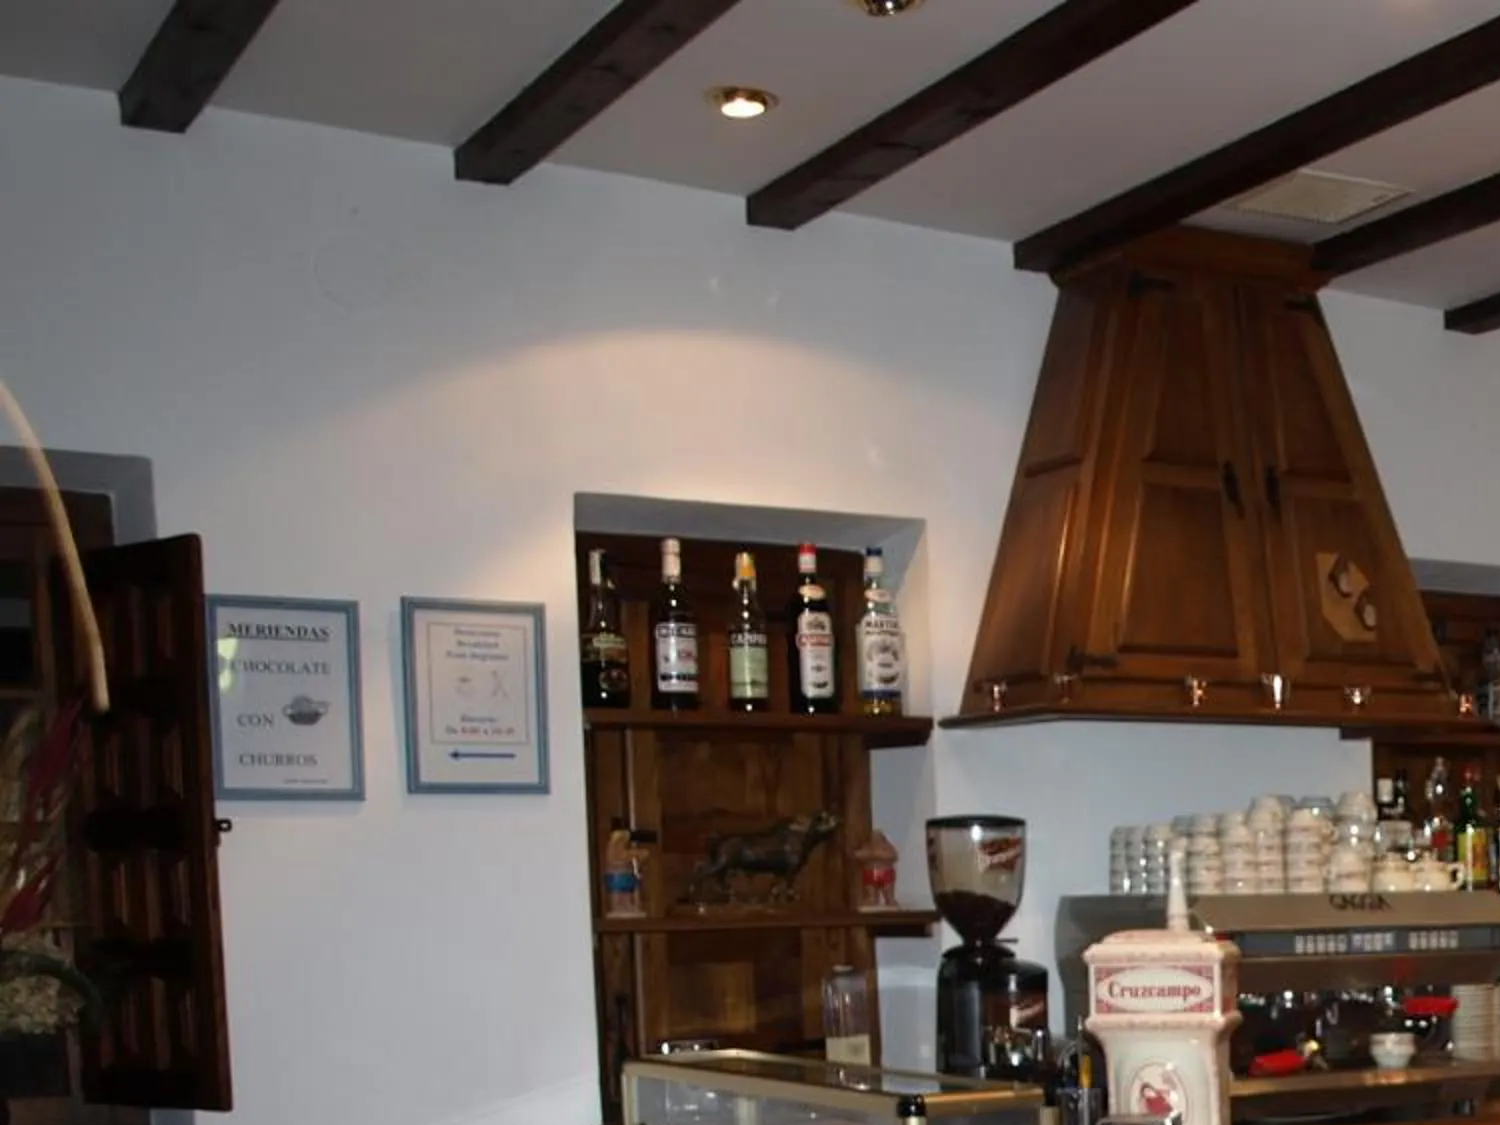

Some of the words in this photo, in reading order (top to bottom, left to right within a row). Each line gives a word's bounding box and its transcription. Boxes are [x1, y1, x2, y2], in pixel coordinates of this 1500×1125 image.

[226, 622, 330, 641] MERIENDAS
[231, 658, 331, 676] CHOCOLATE
[237, 712, 275, 729] CON
[238, 752, 319, 768] CHURROS
[1108, 979, 1202, 1002] Cruzcampo
